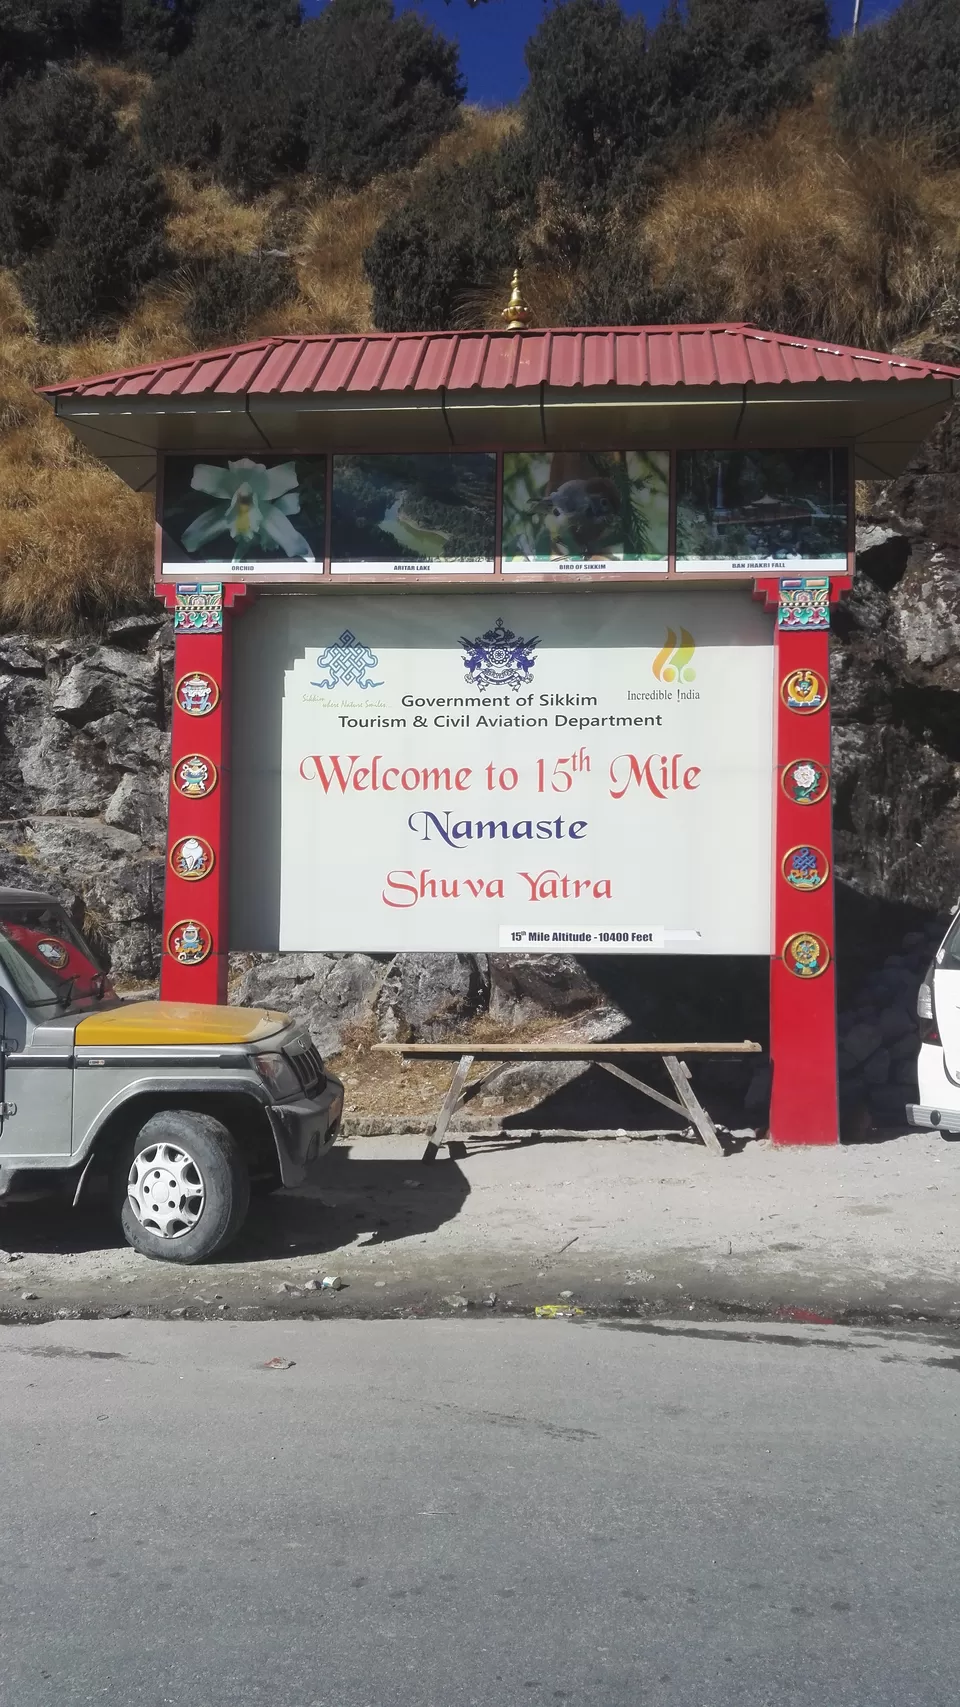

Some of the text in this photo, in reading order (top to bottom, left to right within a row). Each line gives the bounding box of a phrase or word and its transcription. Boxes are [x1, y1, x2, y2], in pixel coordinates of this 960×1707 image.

[302, 693, 325, 702] Sikkim
[401, 694, 598, 707] Government of Sikkim
[628, 690, 672, 700] Incredible
[322, 700, 339, 708] where
[341, 700, 363, 708] Nature
[338, 715, 662, 730] Tourism & Civil Aviation Department
[300, 756, 472, 794] Welcome
[485, 762, 518, 790] to
[610, 754, 701, 799] Mile
[408, 811, 588, 848] Namaste
[382, 870, 612, 908] Shuva Yatra
[528, 932, 550, 942] Mile
[552, 932, 592, 942] Altitude
[631, 932, 653, 942] Feet
